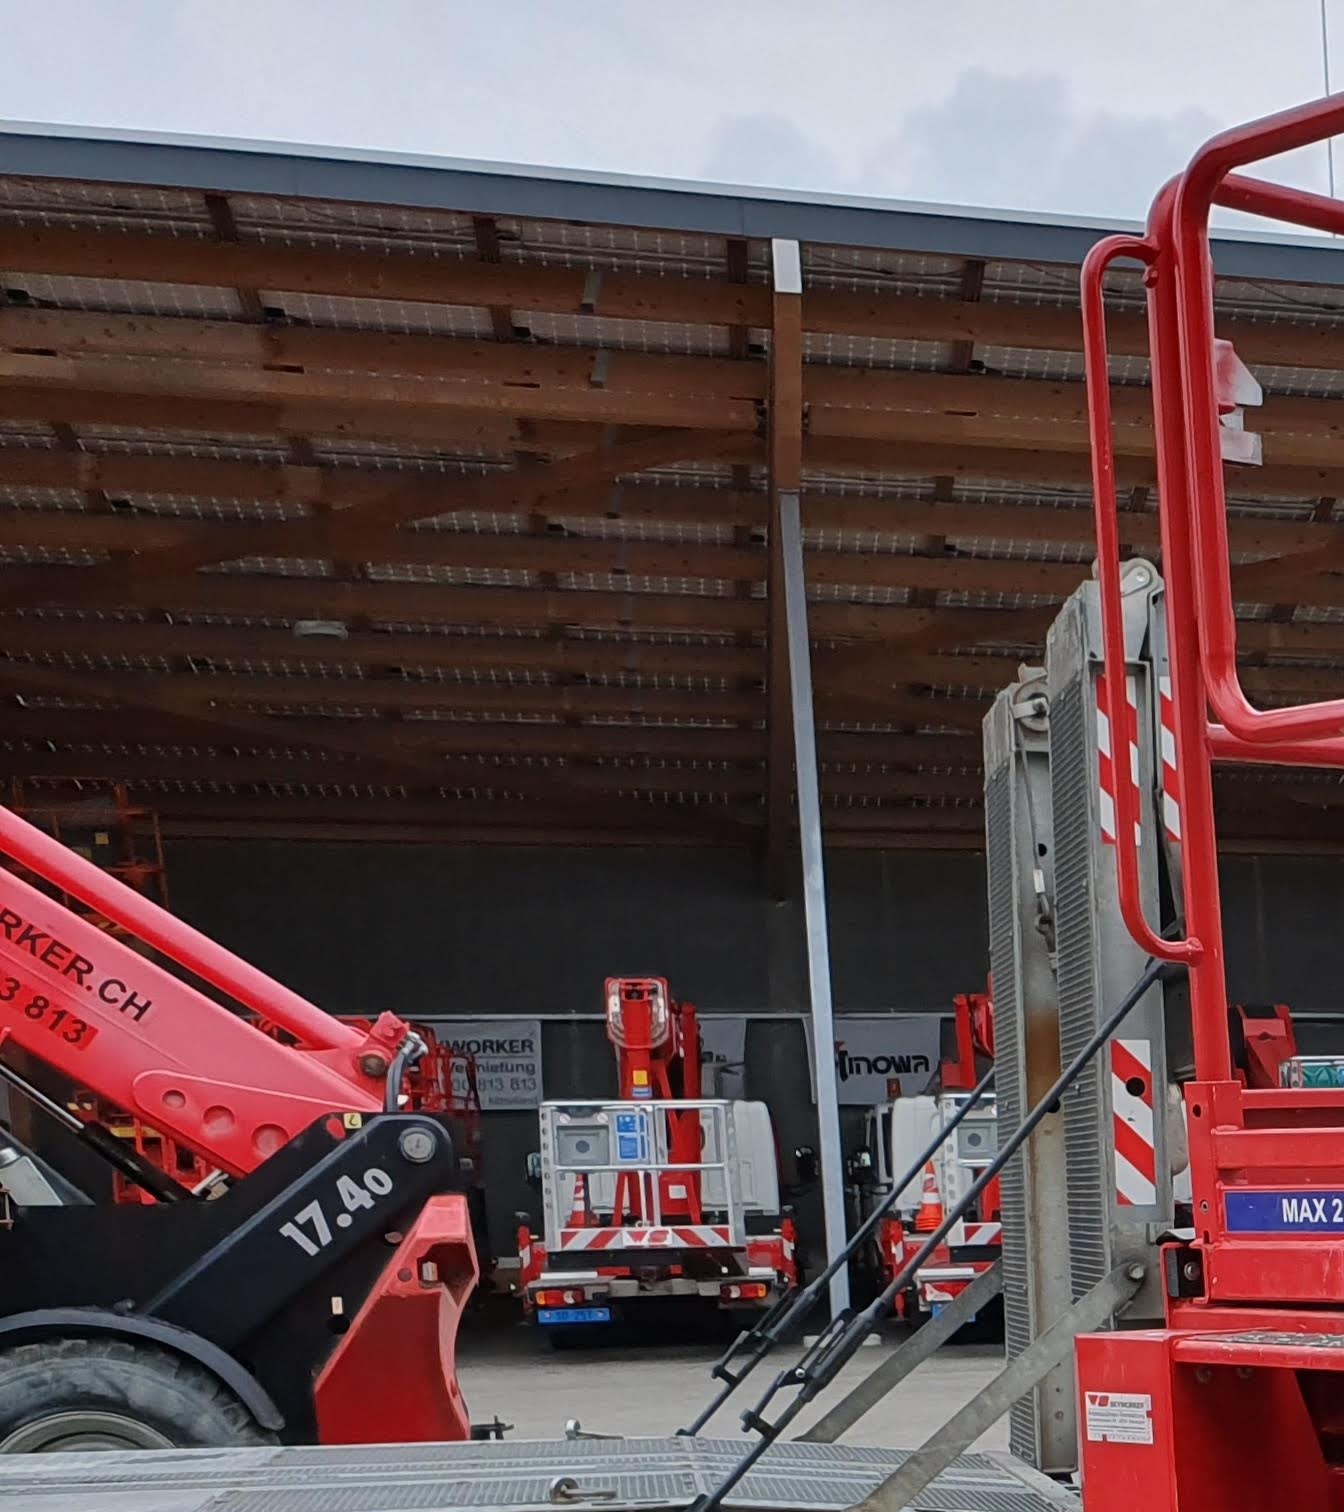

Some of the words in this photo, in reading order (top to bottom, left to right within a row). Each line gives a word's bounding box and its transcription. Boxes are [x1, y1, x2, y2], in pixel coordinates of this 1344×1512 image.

[24, 995, 87, 1043] 813
[279, 1167, 393, 1257] 17.40
[1282, 1198, 1328, 1223] MAX
